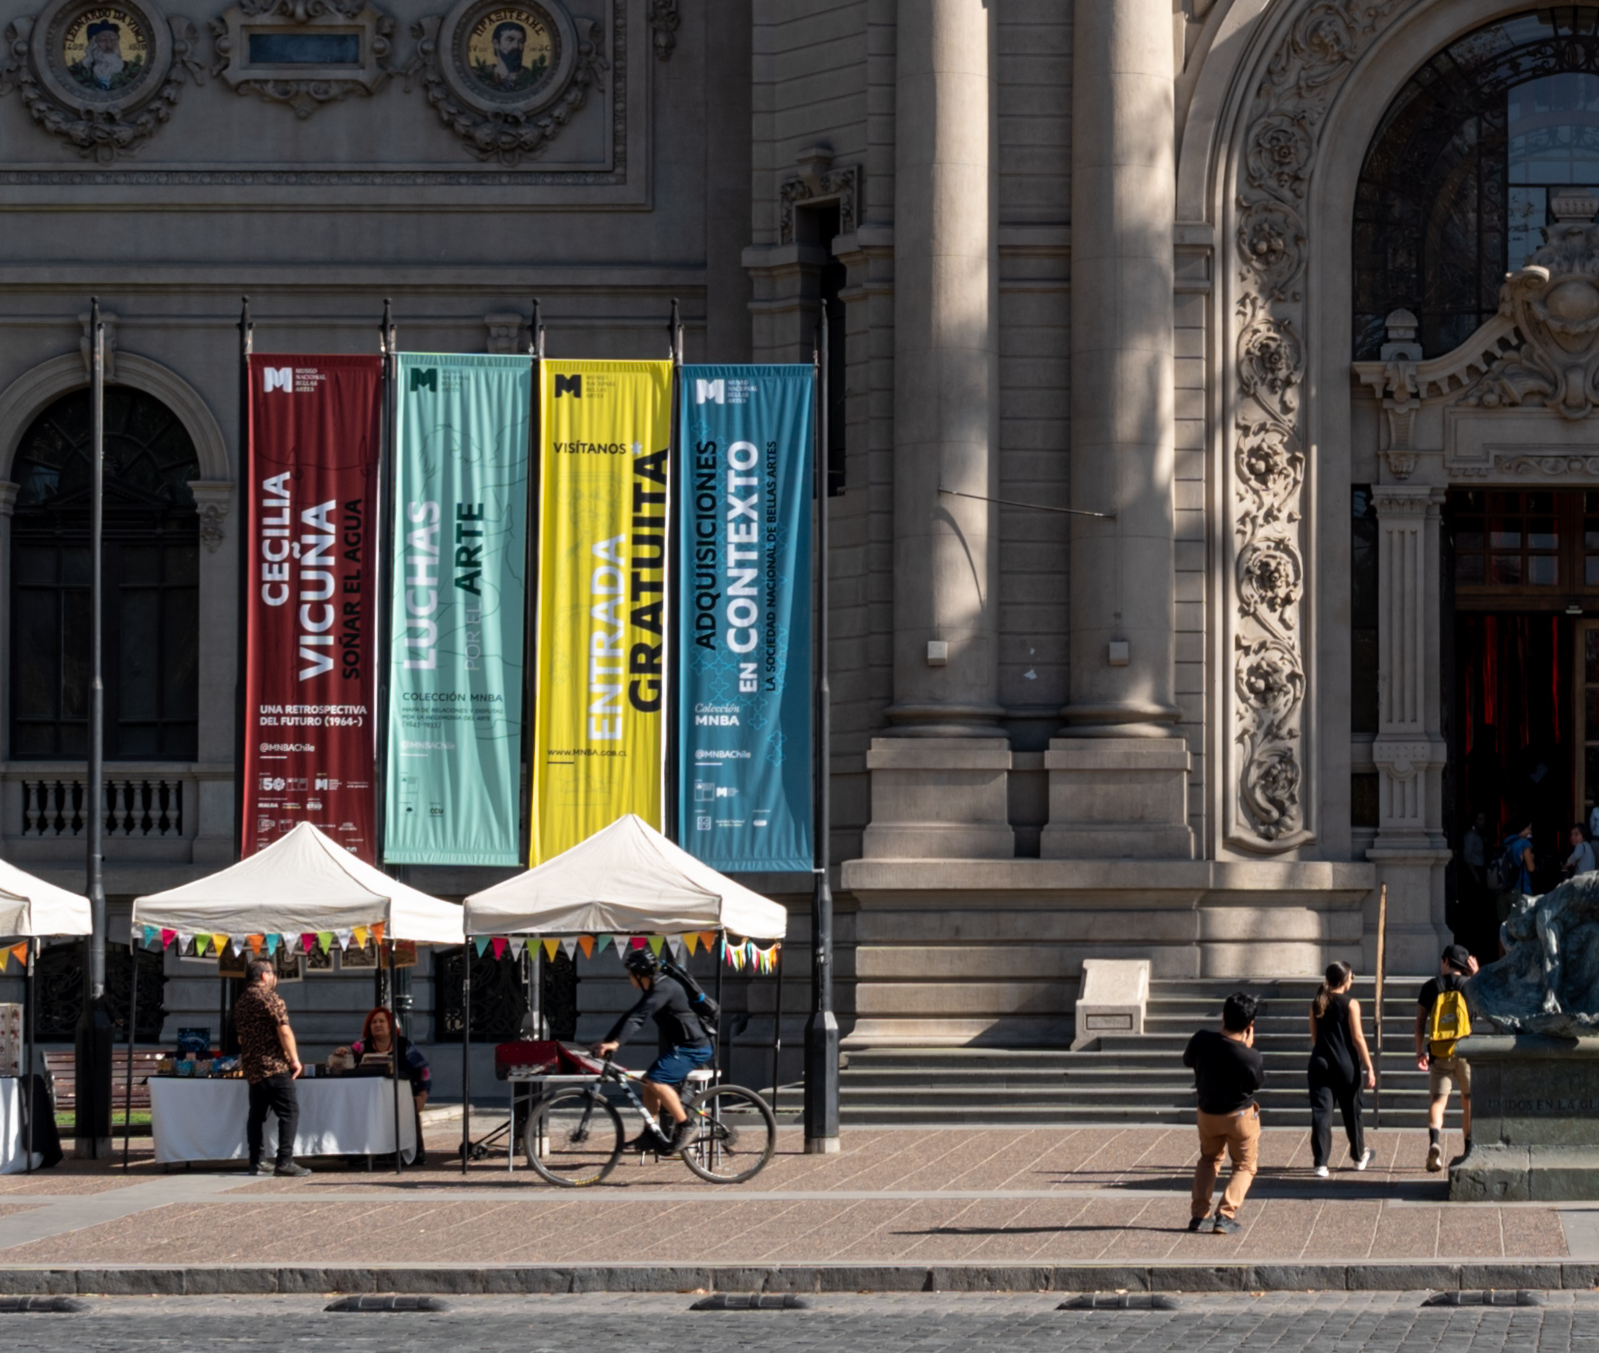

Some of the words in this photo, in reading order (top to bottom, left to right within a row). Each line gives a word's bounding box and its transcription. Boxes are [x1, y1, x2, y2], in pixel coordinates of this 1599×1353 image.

[553, 440, 626, 454] VISÍTANOS
[767, 441, 777, 479] ARTES
[767, 481, 777, 524] BELLAS
[261, 471, 291, 607] CECILIA
[343, 498, 363, 563] AGUA
[454, 503, 484, 597] ARTE
[695, 440, 721, 651] ADQUISICIONES
[726, 440, 758, 654] CONTEXTO
[767, 527, 777, 543] DE
[291, 499, 336, 682] VICUÑA
[343, 569, 361, 594] EL
[403, 500, 440, 670] LUCHAS
[628, 448, 669, 713] GRATUITA
[766, 547, 776, 608] NACIONAL
[466, 602, 482, 624] EL
[338, 601, 361, 680] SOÑAR
[464, 631, 481, 671] POR
[588, 533, 625, 741] ENTRADA
[766, 611, 776, 672] SOCIEDAD
[402, 691, 465, 701] COLECCIÓN
[470, 693, 503, 702] MNBA
[739, 663, 758, 693] EN
[766, 679, 776, 691] LA
[259, 704, 283, 714] UNA
[285, 704, 367, 714] RETROSPECTIVA
[259, 716, 278, 726] DEL
[281, 716, 322, 726] FUTURO
[324, 715, 363, 727] (1964-)
[694, 702, 740, 713] Colección
[695, 715, 740, 726] MNBA
[1536, 1098, 1554, 1110] EN
[1558, 1098, 1576, 1110] LA
